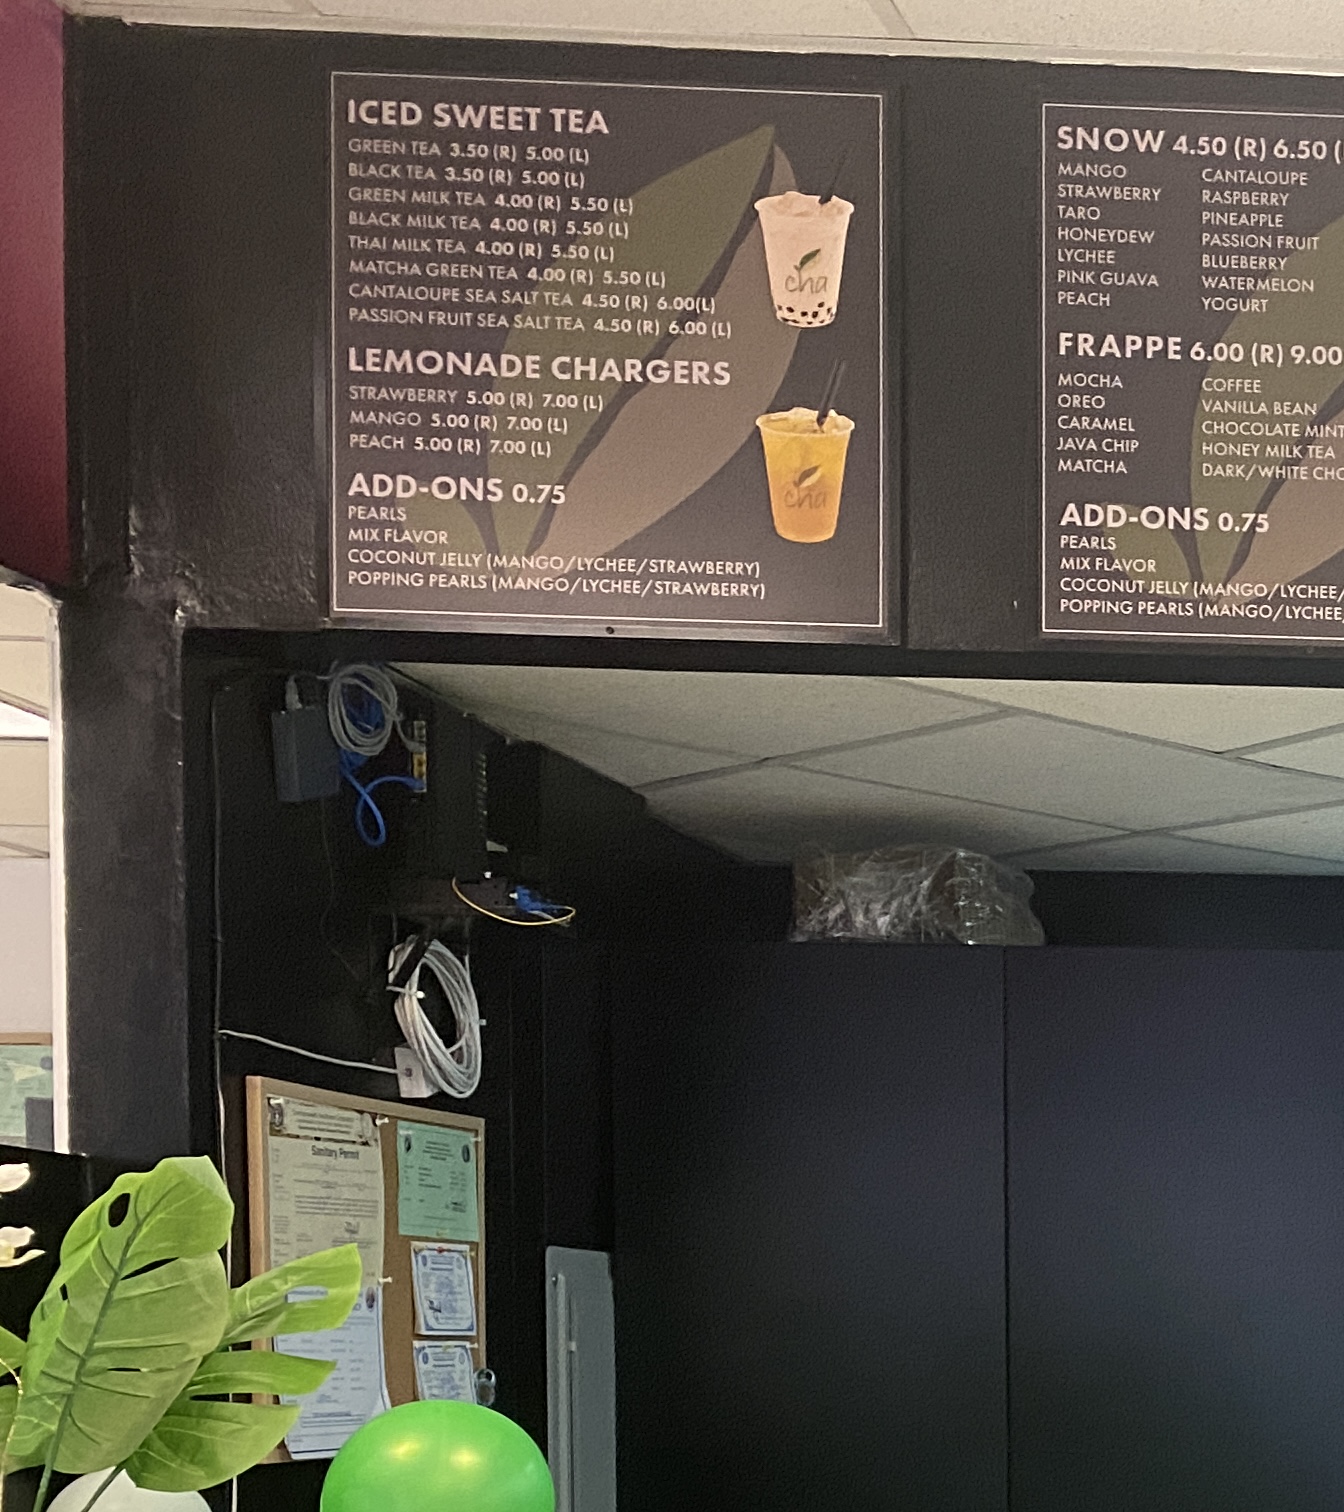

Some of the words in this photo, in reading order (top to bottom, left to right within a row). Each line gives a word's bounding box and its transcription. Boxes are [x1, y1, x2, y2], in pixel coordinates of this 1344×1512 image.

[347, 98, 423, 126] ICED
[433, 102, 542, 132] SWEET
[548, 107, 610, 134] TEA
[1056, 125, 1166, 153] SNOW
[1171, 134, 1227, 156] 4.50
[1233, 135, 1266, 161] (R)
[1272, 138, 1327, 160] 6.50
[1057, 162, 1127, 179] MANGO
[1201, 167, 1308, 186] CANTALOUPE
[1057, 183, 1162, 202] STRAWBERRY
[1201, 188, 1290, 206] RASPBERRY
[1057, 204, 1101, 221] TARO
[1201, 210, 1283, 228] PINEAPPLE
[348, 210, 401, 227] BLACK
[406, 214, 446, 229] MILK
[450, 215, 481, 230] TEA
[489, 216, 529, 233] 4.00
[532, 218, 557, 236] (R)
[565, 220, 604, 236] 5.50
[608, 221, 629, 239] (L)
[1057, 226, 1155, 244] HONEYDEW
[1201, 232, 1272, 249] PASSION
[1276, 234, 1320, 250] FRUIT
[1057, 248, 1115, 264] LYCHEE
[1201, 253, 1288, 271] BLUEBERRY
[784, 261, 828, 294] cha
[1057, 268, 1096, 285] PINK
[1099, 270, 1159, 287] GUAVA
[1200, 274, 1314, 293] WATERMELON
[1057, 290, 1110, 307] PEACH
[1200, 296, 1269, 313] YOGURT
[1058, 331, 1182, 360] FRAPPE
[1189, 341, 1244, 362] 6.00
[1251, 342, 1283, 368] (R)
[1290, 344, 1343, 365] 9.00
[348, 346, 541, 379] LEMONADE
[551, 355, 731, 386] CHARGERS
[1057, 372, 1124, 389] MOCHA
[1201, 377, 1262, 394] COFFEE
[1057, 393, 1106, 409] OREO
[1057, 414, 1135, 432] CARAMEL
[1056, 436, 1098, 452] JAVA
[1101, 437, 1139, 453] CHIP
[1057, 458, 1128, 474] MATCHA
[347, 471, 504, 502] ADD-ONS
[512, 483, 566, 504] 0.75
[784, 479, 827, 510] cha
[347, 504, 407, 522] PEARLS
[1059, 502, 1210, 531] ADD-ONS
[1217, 511, 1269, 533] 0.75
[347, 527, 380, 542] MIX
[383, 527, 448, 544] FLAVOR
[347, 548, 436, 565] COCONUT
[439, 551, 483, 567] JELLY
[486, 553, 760, 579] (MANGO/LYCHEE/STRAWBERRY)
[348, 570, 424, 587] POPPING
[428, 573, 487, 589] PEARLS
[491, 574, 766, 600] (MANGO/LYCHEE/STRAWBERRY)
